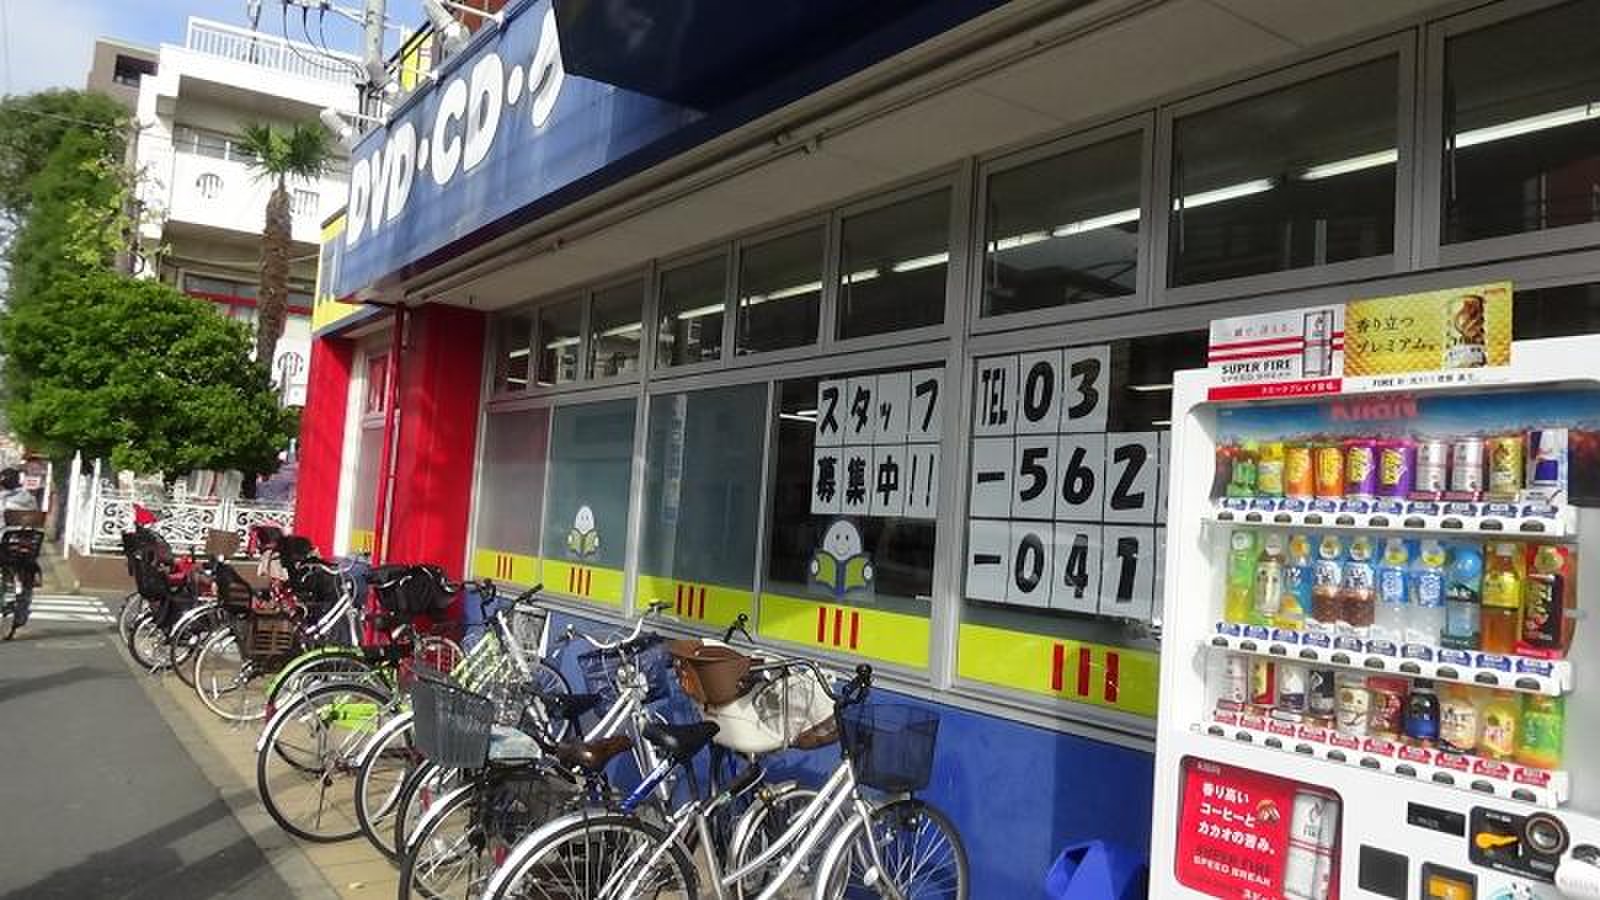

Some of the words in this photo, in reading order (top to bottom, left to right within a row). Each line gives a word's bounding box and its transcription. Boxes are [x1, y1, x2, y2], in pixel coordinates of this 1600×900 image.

[1221, 362, 1260, 375] SUPER
[1263, 359, 1293, 372] FIRE
[820, 379, 938, 434] スタッフ
[981, 369, 1008, 426] TEL
[1024, 358, 1101, 423] 03
[977, 443, 1168, 510] -562
[1199, 802, 1257, 828] コーヒーと
[1192, 855, 1230, 874] SPEED
